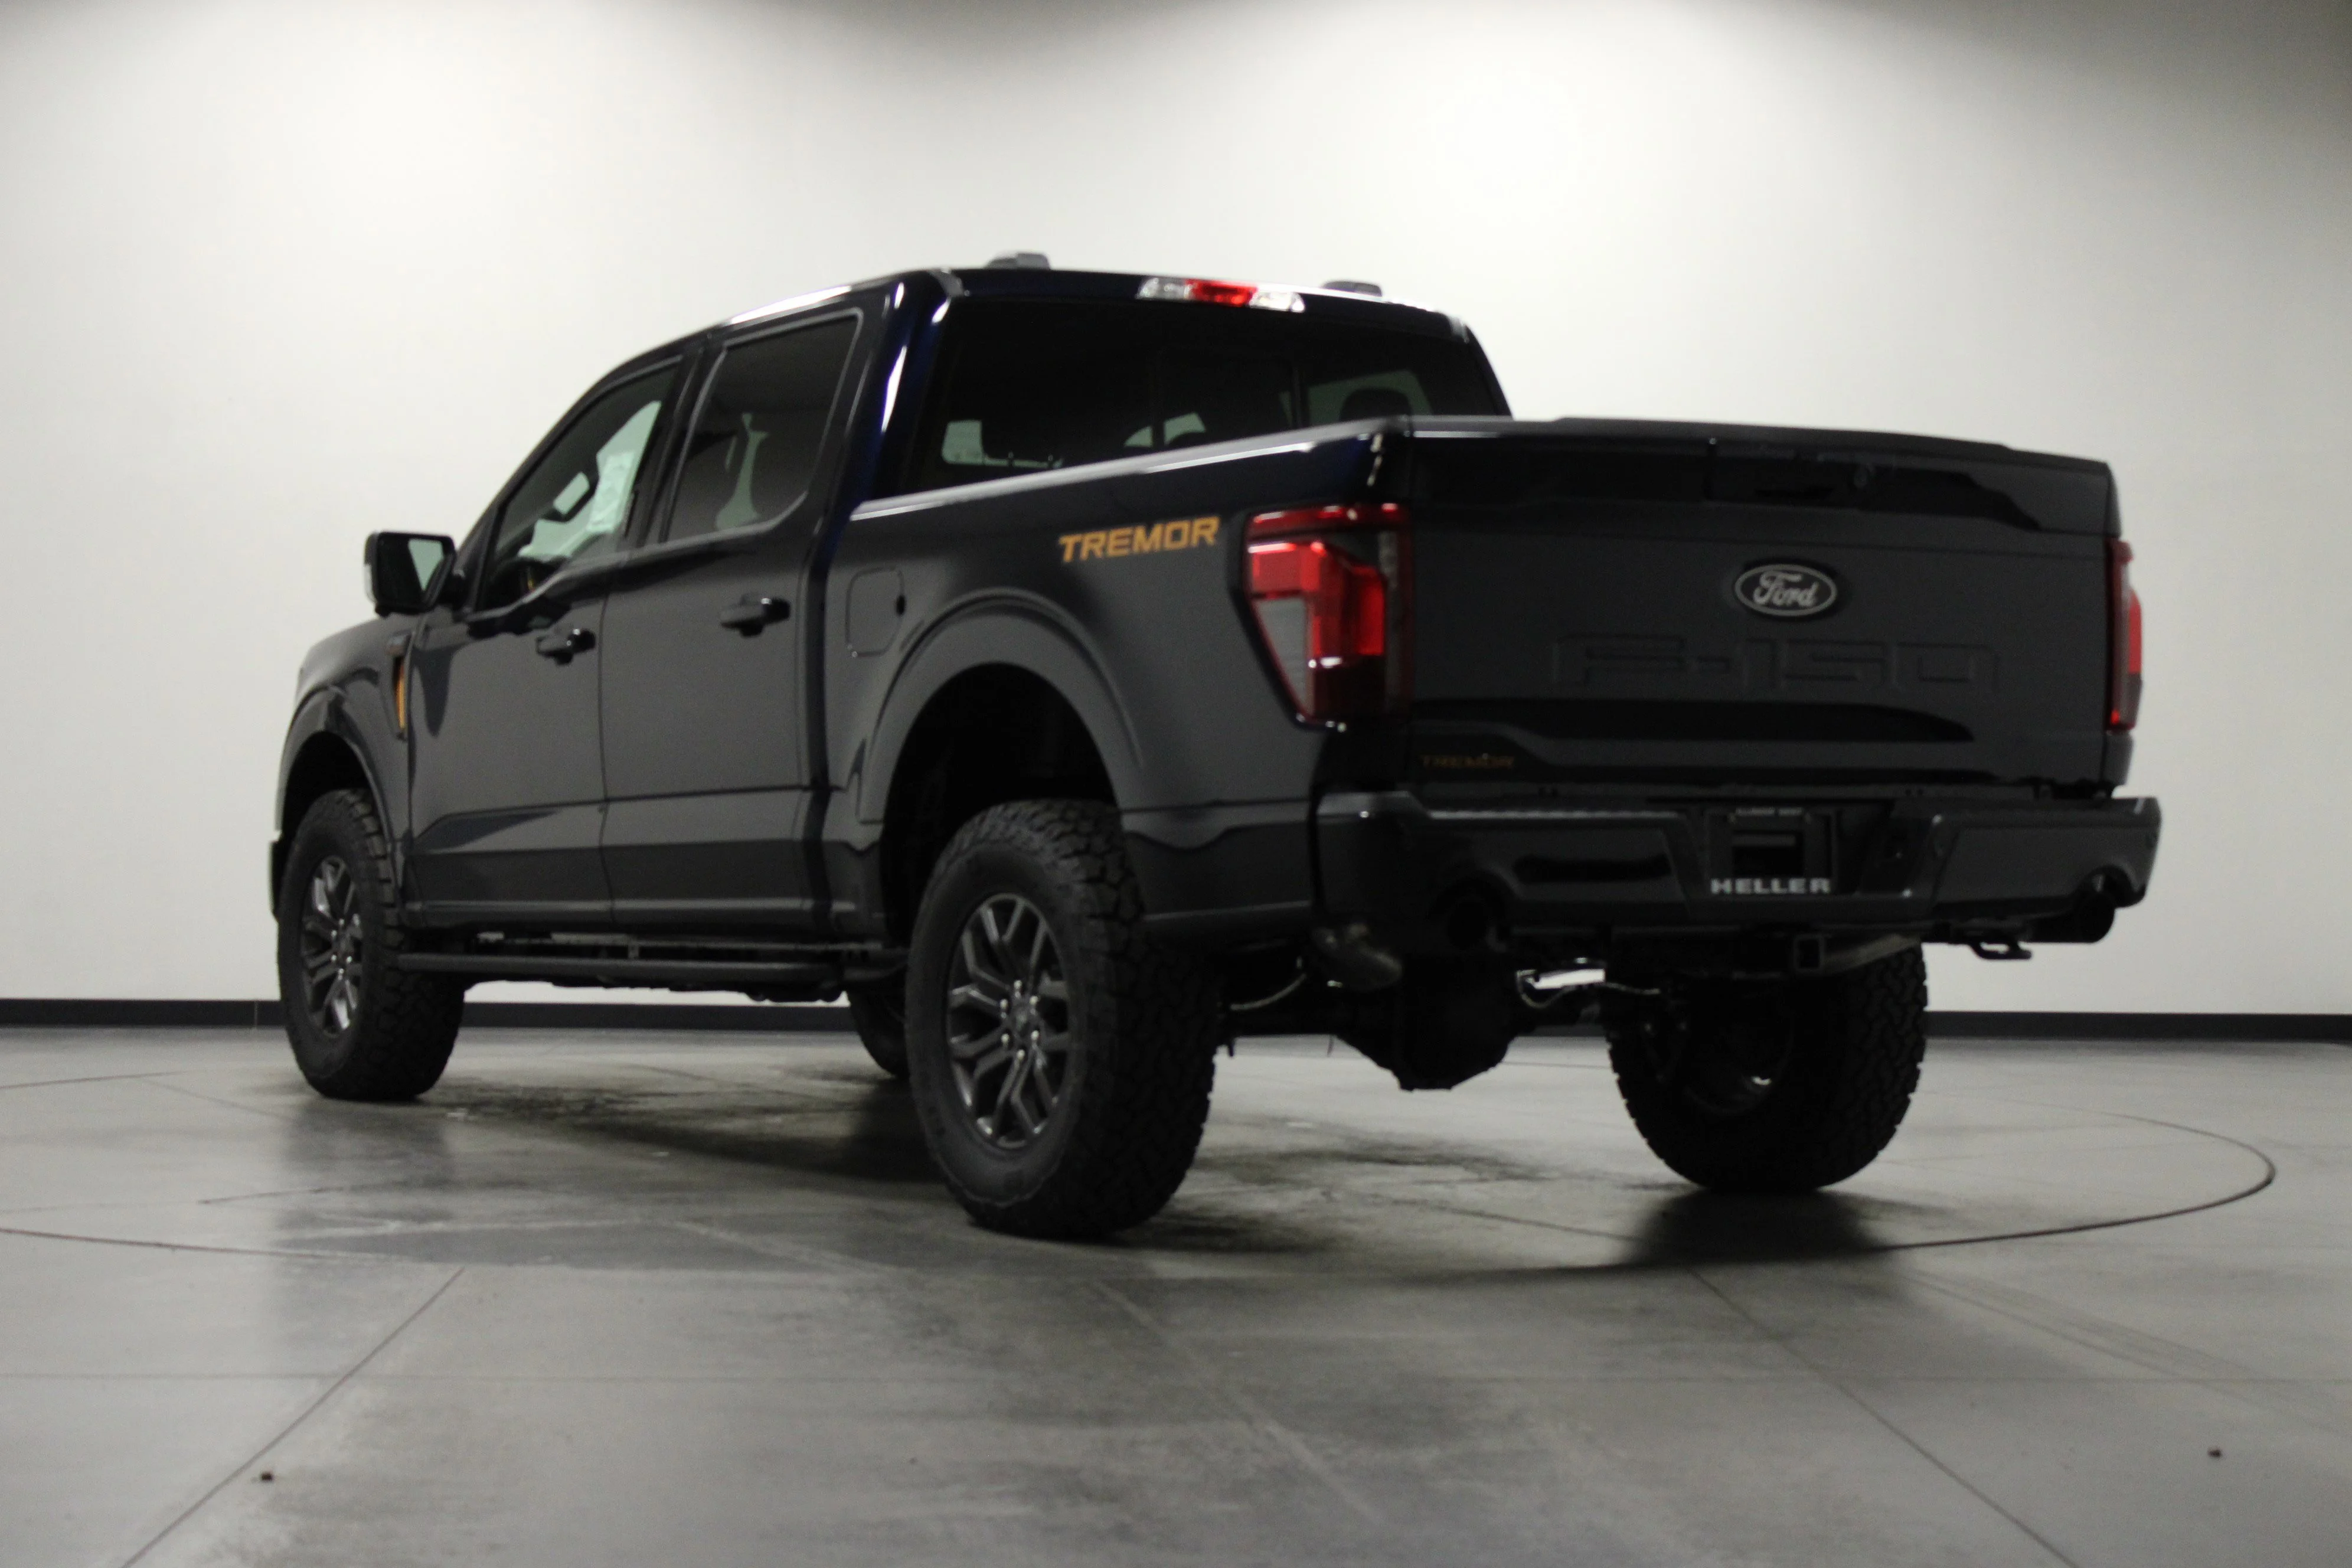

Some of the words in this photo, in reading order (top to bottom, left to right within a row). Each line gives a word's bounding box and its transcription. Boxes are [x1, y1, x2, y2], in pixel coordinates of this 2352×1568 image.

[1059, 516, 1220, 562] TREMOR
[1753, 570, 1819, 607] Ford
[1551, 633, 2000, 692] F-150
[1710, 877, 1830, 894] HELLER
